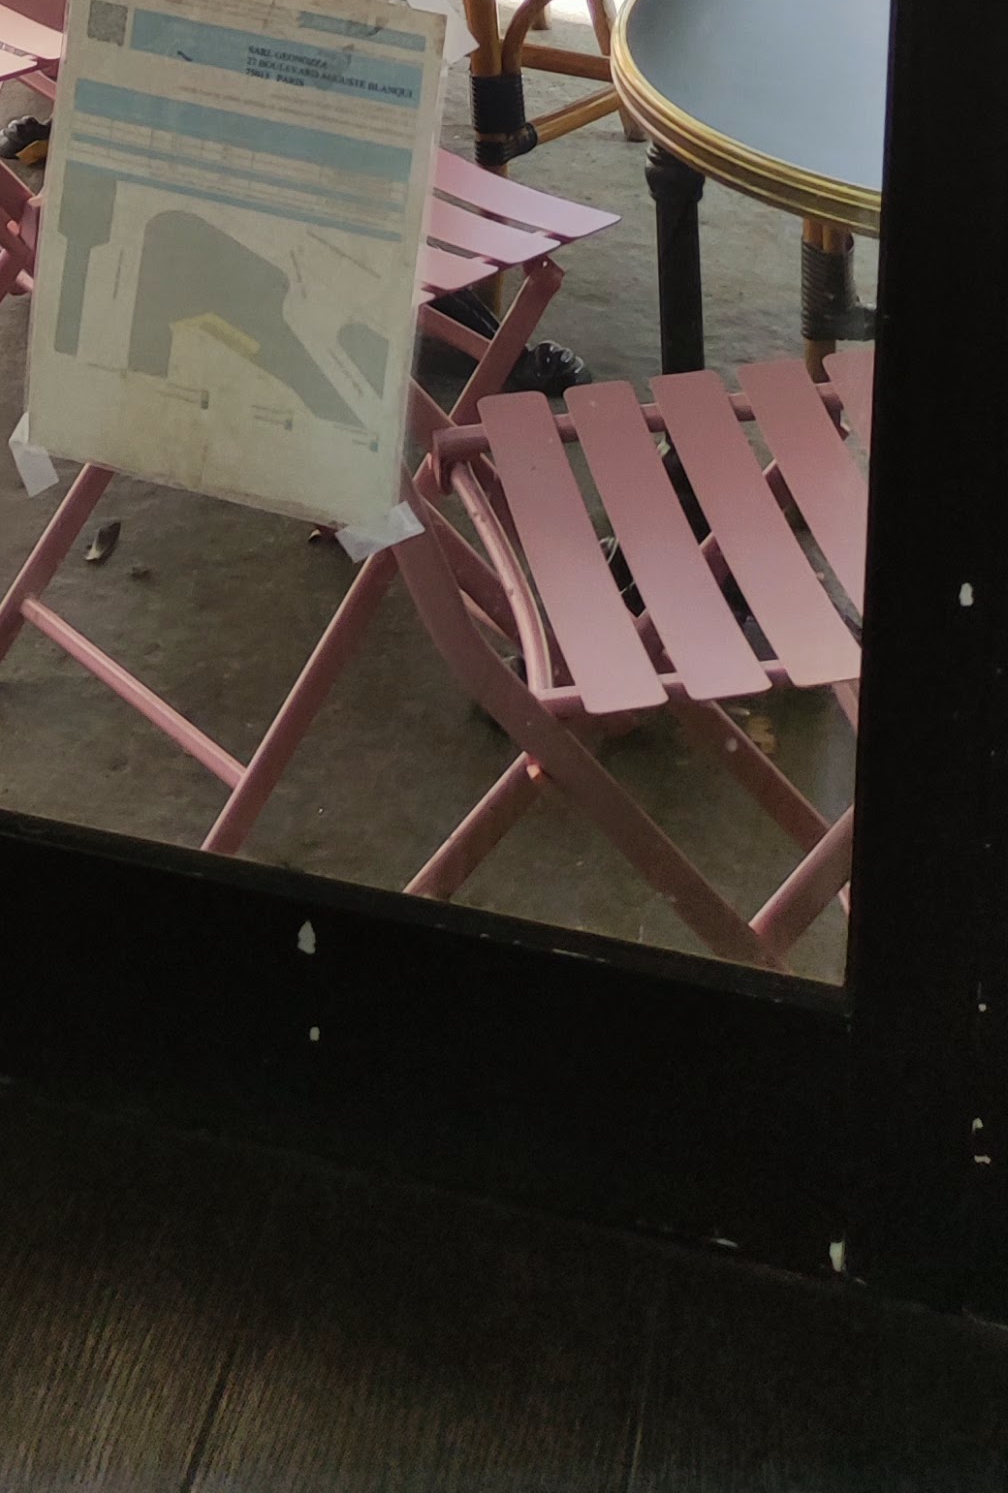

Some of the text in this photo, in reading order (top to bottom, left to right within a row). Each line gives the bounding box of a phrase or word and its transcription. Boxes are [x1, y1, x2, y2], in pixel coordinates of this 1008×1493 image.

[258, 57, 320, 80] BOULEVARD
[320, 71, 366, 90] AUGUSTE
[367, 80, 413, 98] BLANQUI
[276, 73, 305, 87] PARIS
